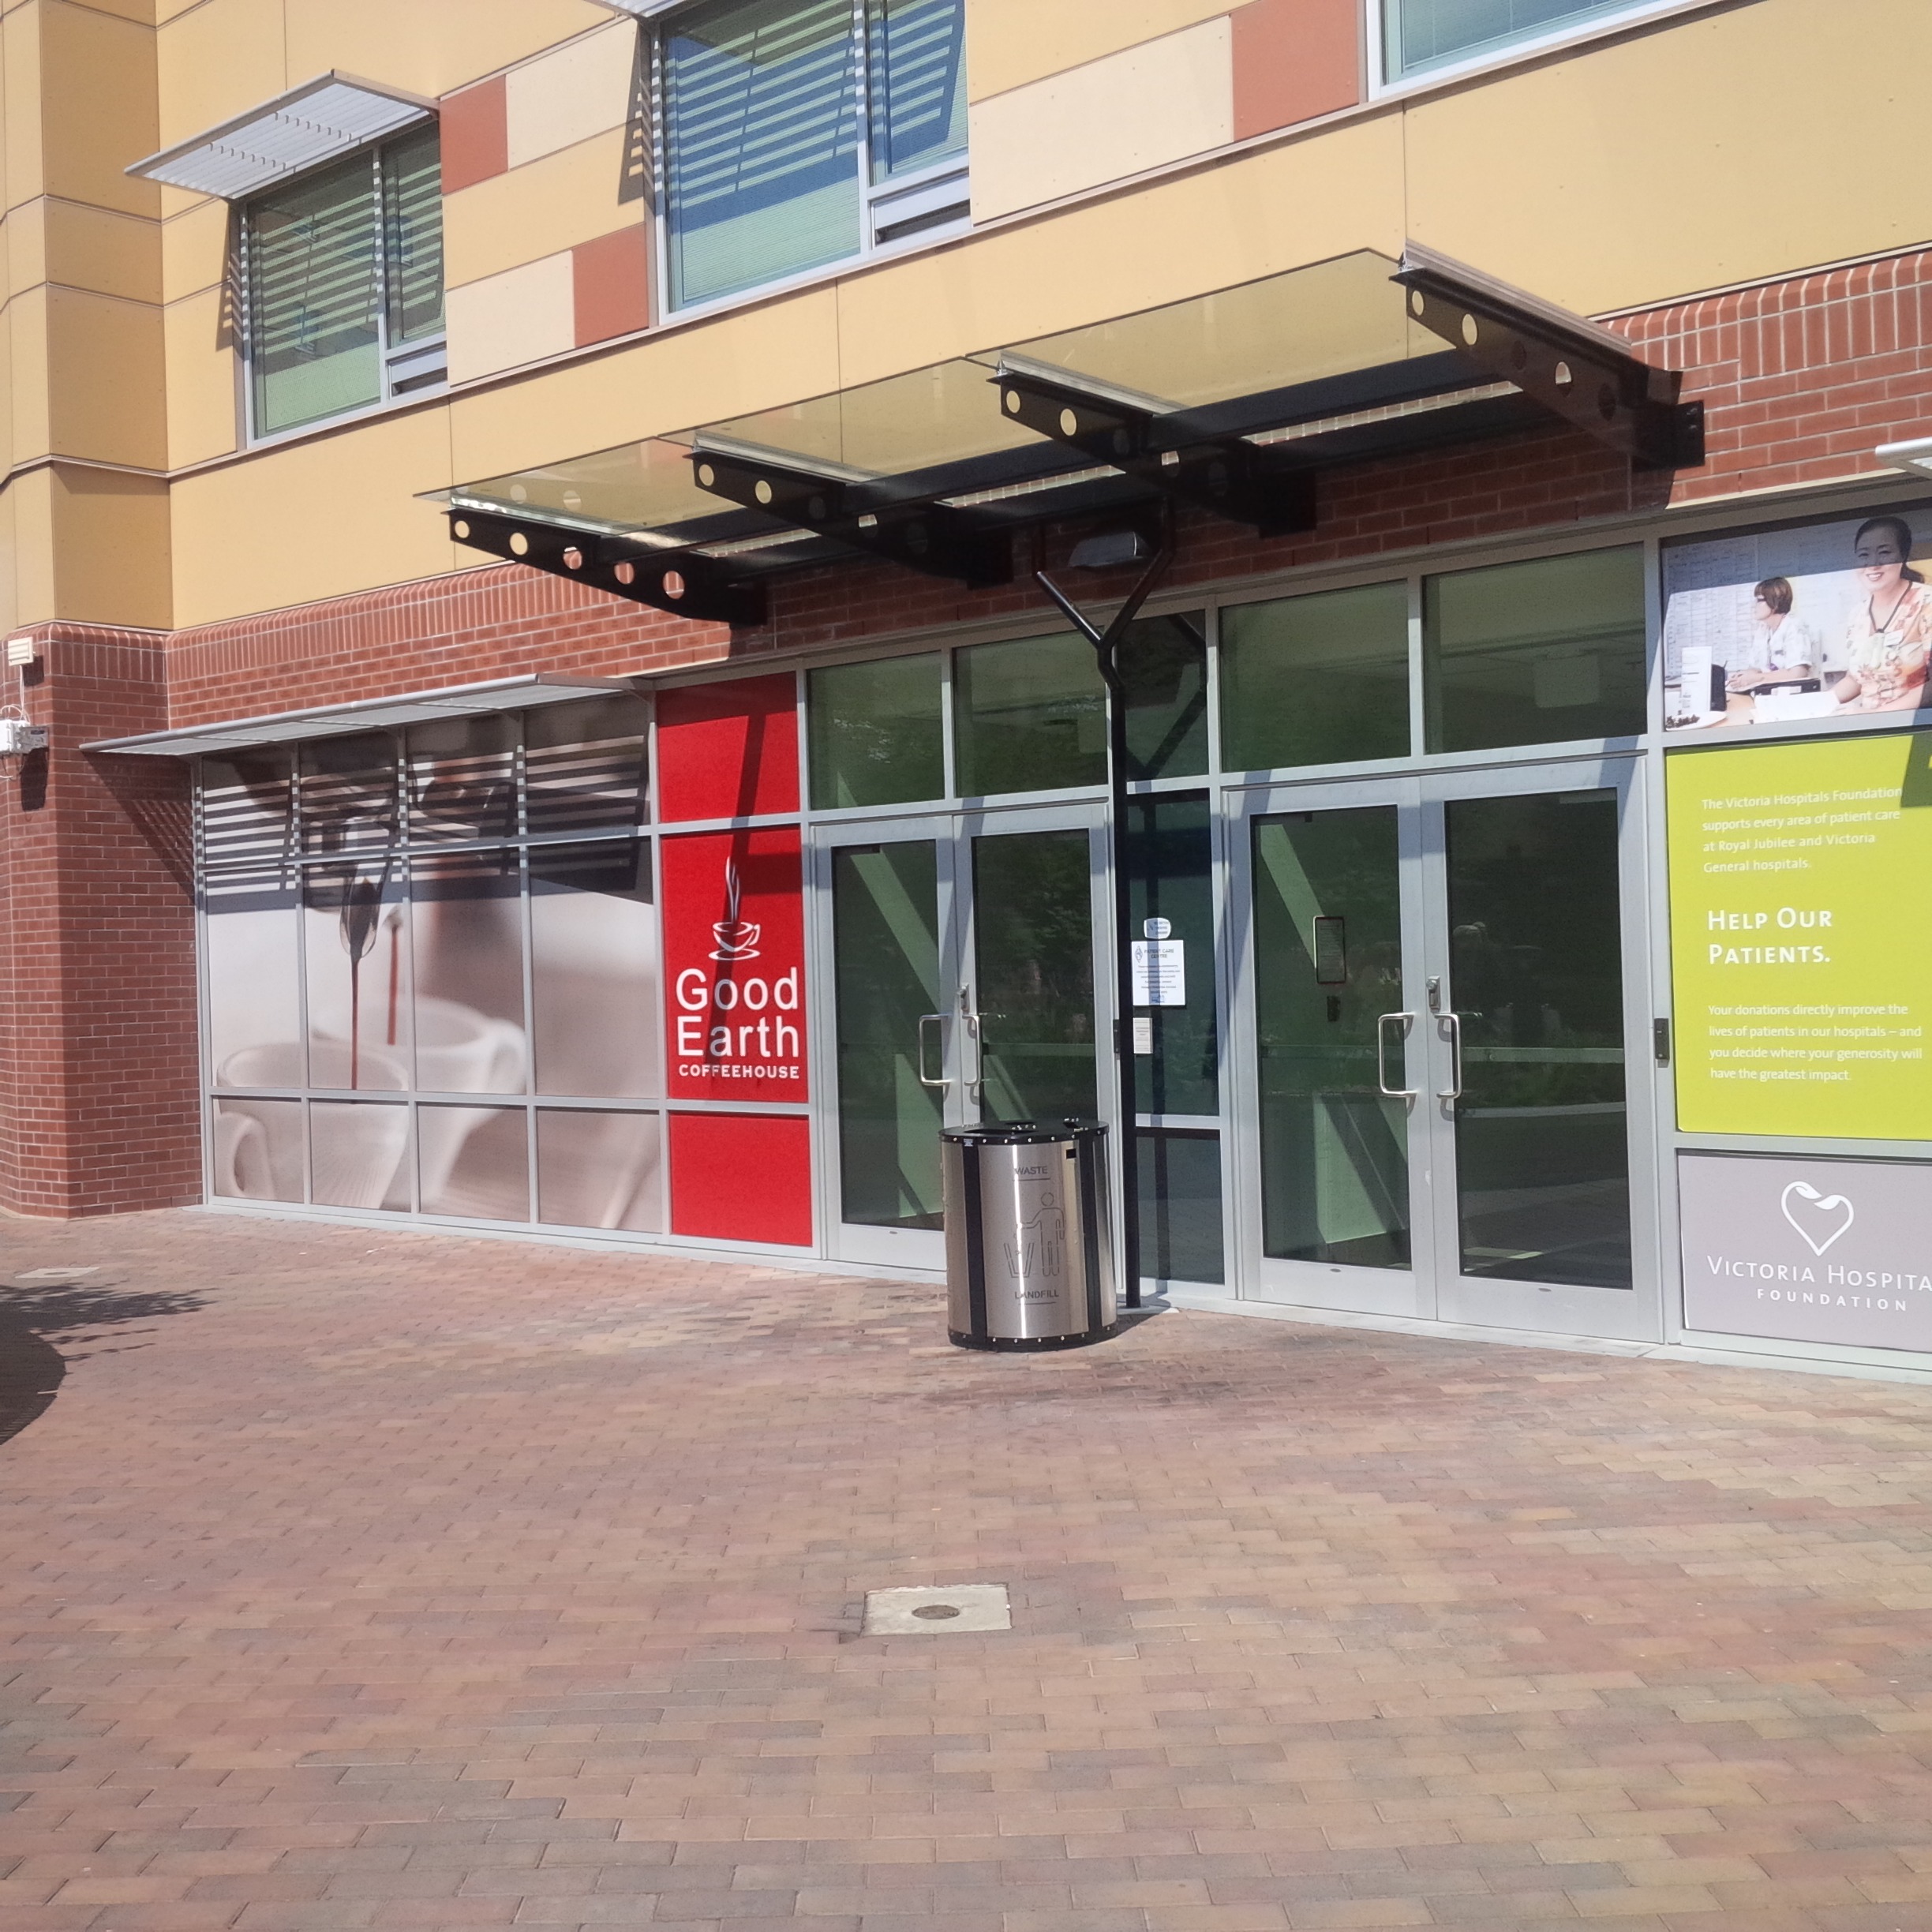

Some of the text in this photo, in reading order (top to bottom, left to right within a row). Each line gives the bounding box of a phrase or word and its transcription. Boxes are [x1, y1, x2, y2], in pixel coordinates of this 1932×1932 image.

[1702, 788, 1903, 810] The Victoria Hospitals Foundation
[1702, 810, 1900, 833] supports every area of patient care
[1703, 833, 1876, 854] at Royal Jubilee and Victoria
[1703, 860, 1750, 873] General
[1708, 907, 1832, 930] HELP OUR
[1709, 944, 1831, 964] PATIENTS.
[675, 966, 799, 1011] Good
[1708, 1003, 1908, 1018] Your donations directly improve the
[676, 1015, 799, 1058] Earth
[1709, 1025, 1733, 1036] lives
[1735, 1025, 1747, 1036] of
[1750, 1026, 1795, 1039] patients
[1798, 1026, 1808, 1036] in
[1810, 1028, 1831, 1037] our
[1833, 1025, 1886, 1040] hospitals
[1899, 1025, 1922, 1037] and
[1709, 1046, 1923, 1062] you decide where your generosity will
[678, 1063, 800, 1080] COFFEEHOUSE
[1710, 1067, 1736, 1078] have
[1738, 1067, 1757, 1079] the
[1759, 1069, 1807, 1082] greatest
[1013, 1165, 1049, 1175] WASTE
[1707, 1255, 1932, 1292] VICTORIA HOSPITA
[1014, 1289, 1059, 1300] LANDFILL
[1757, 1288, 1906, 1312] FOUNDATION
